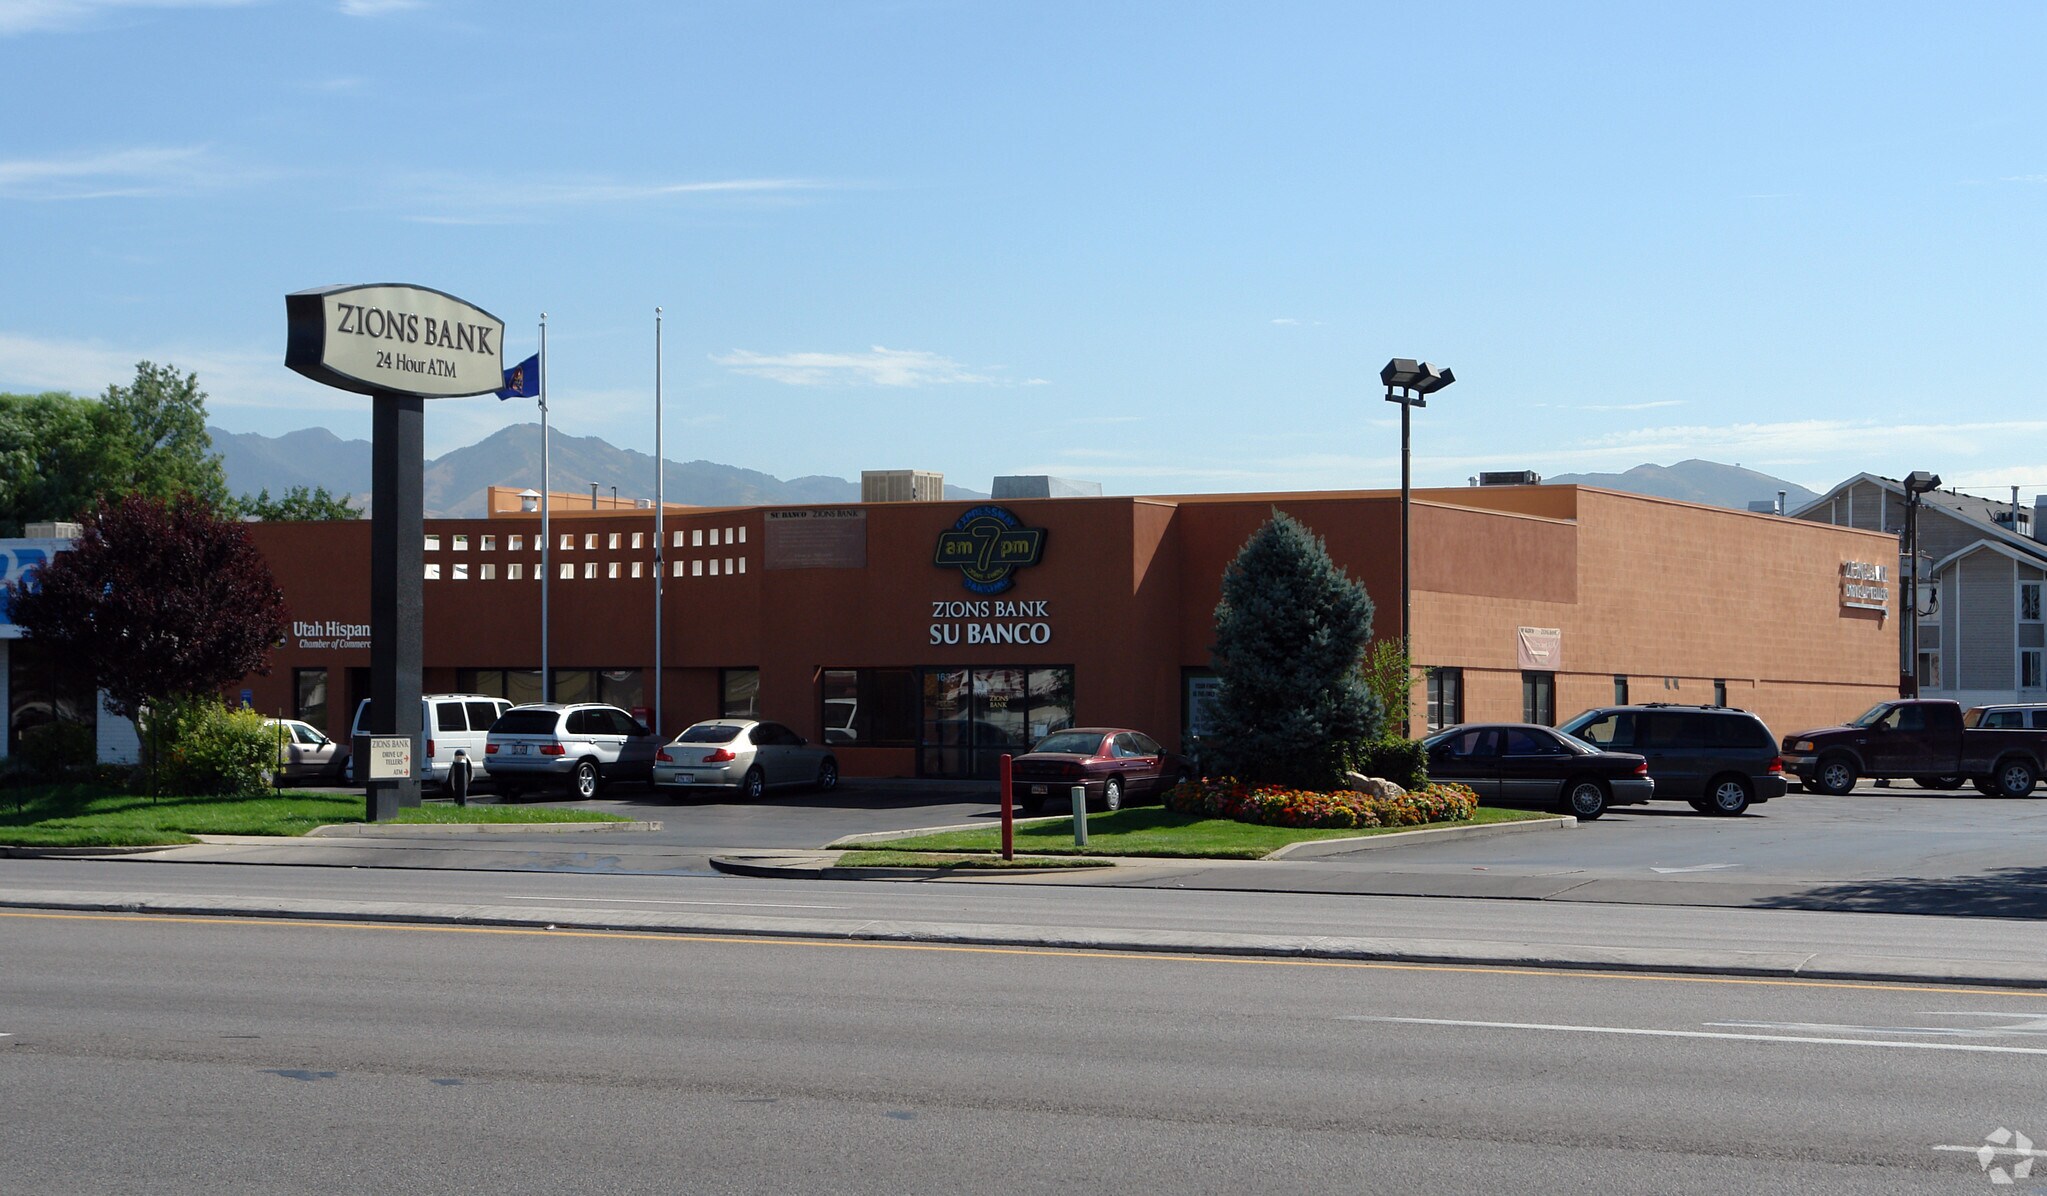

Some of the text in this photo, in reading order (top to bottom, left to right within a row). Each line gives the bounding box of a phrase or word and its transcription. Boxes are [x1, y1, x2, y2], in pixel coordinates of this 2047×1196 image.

[337, 302, 495, 355] ZIONS BANK
[376, 349, 457, 378] 24 Hour ATM
[812, 510, 835, 518] ZIONS
[837, 509, 859, 517] BANK
[945, 526, 1030, 571] am 7 pm
[932, 600, 1049, 618] ZIONS BANK
[293, 621, 324, 637] Utah
[929, 622, 1051, 645] SU BANCO
[299, 639, 330, 649] Chamber
[331, 639, 339, 650] of
[372, 740, 409, 748] ZIONS BANK
